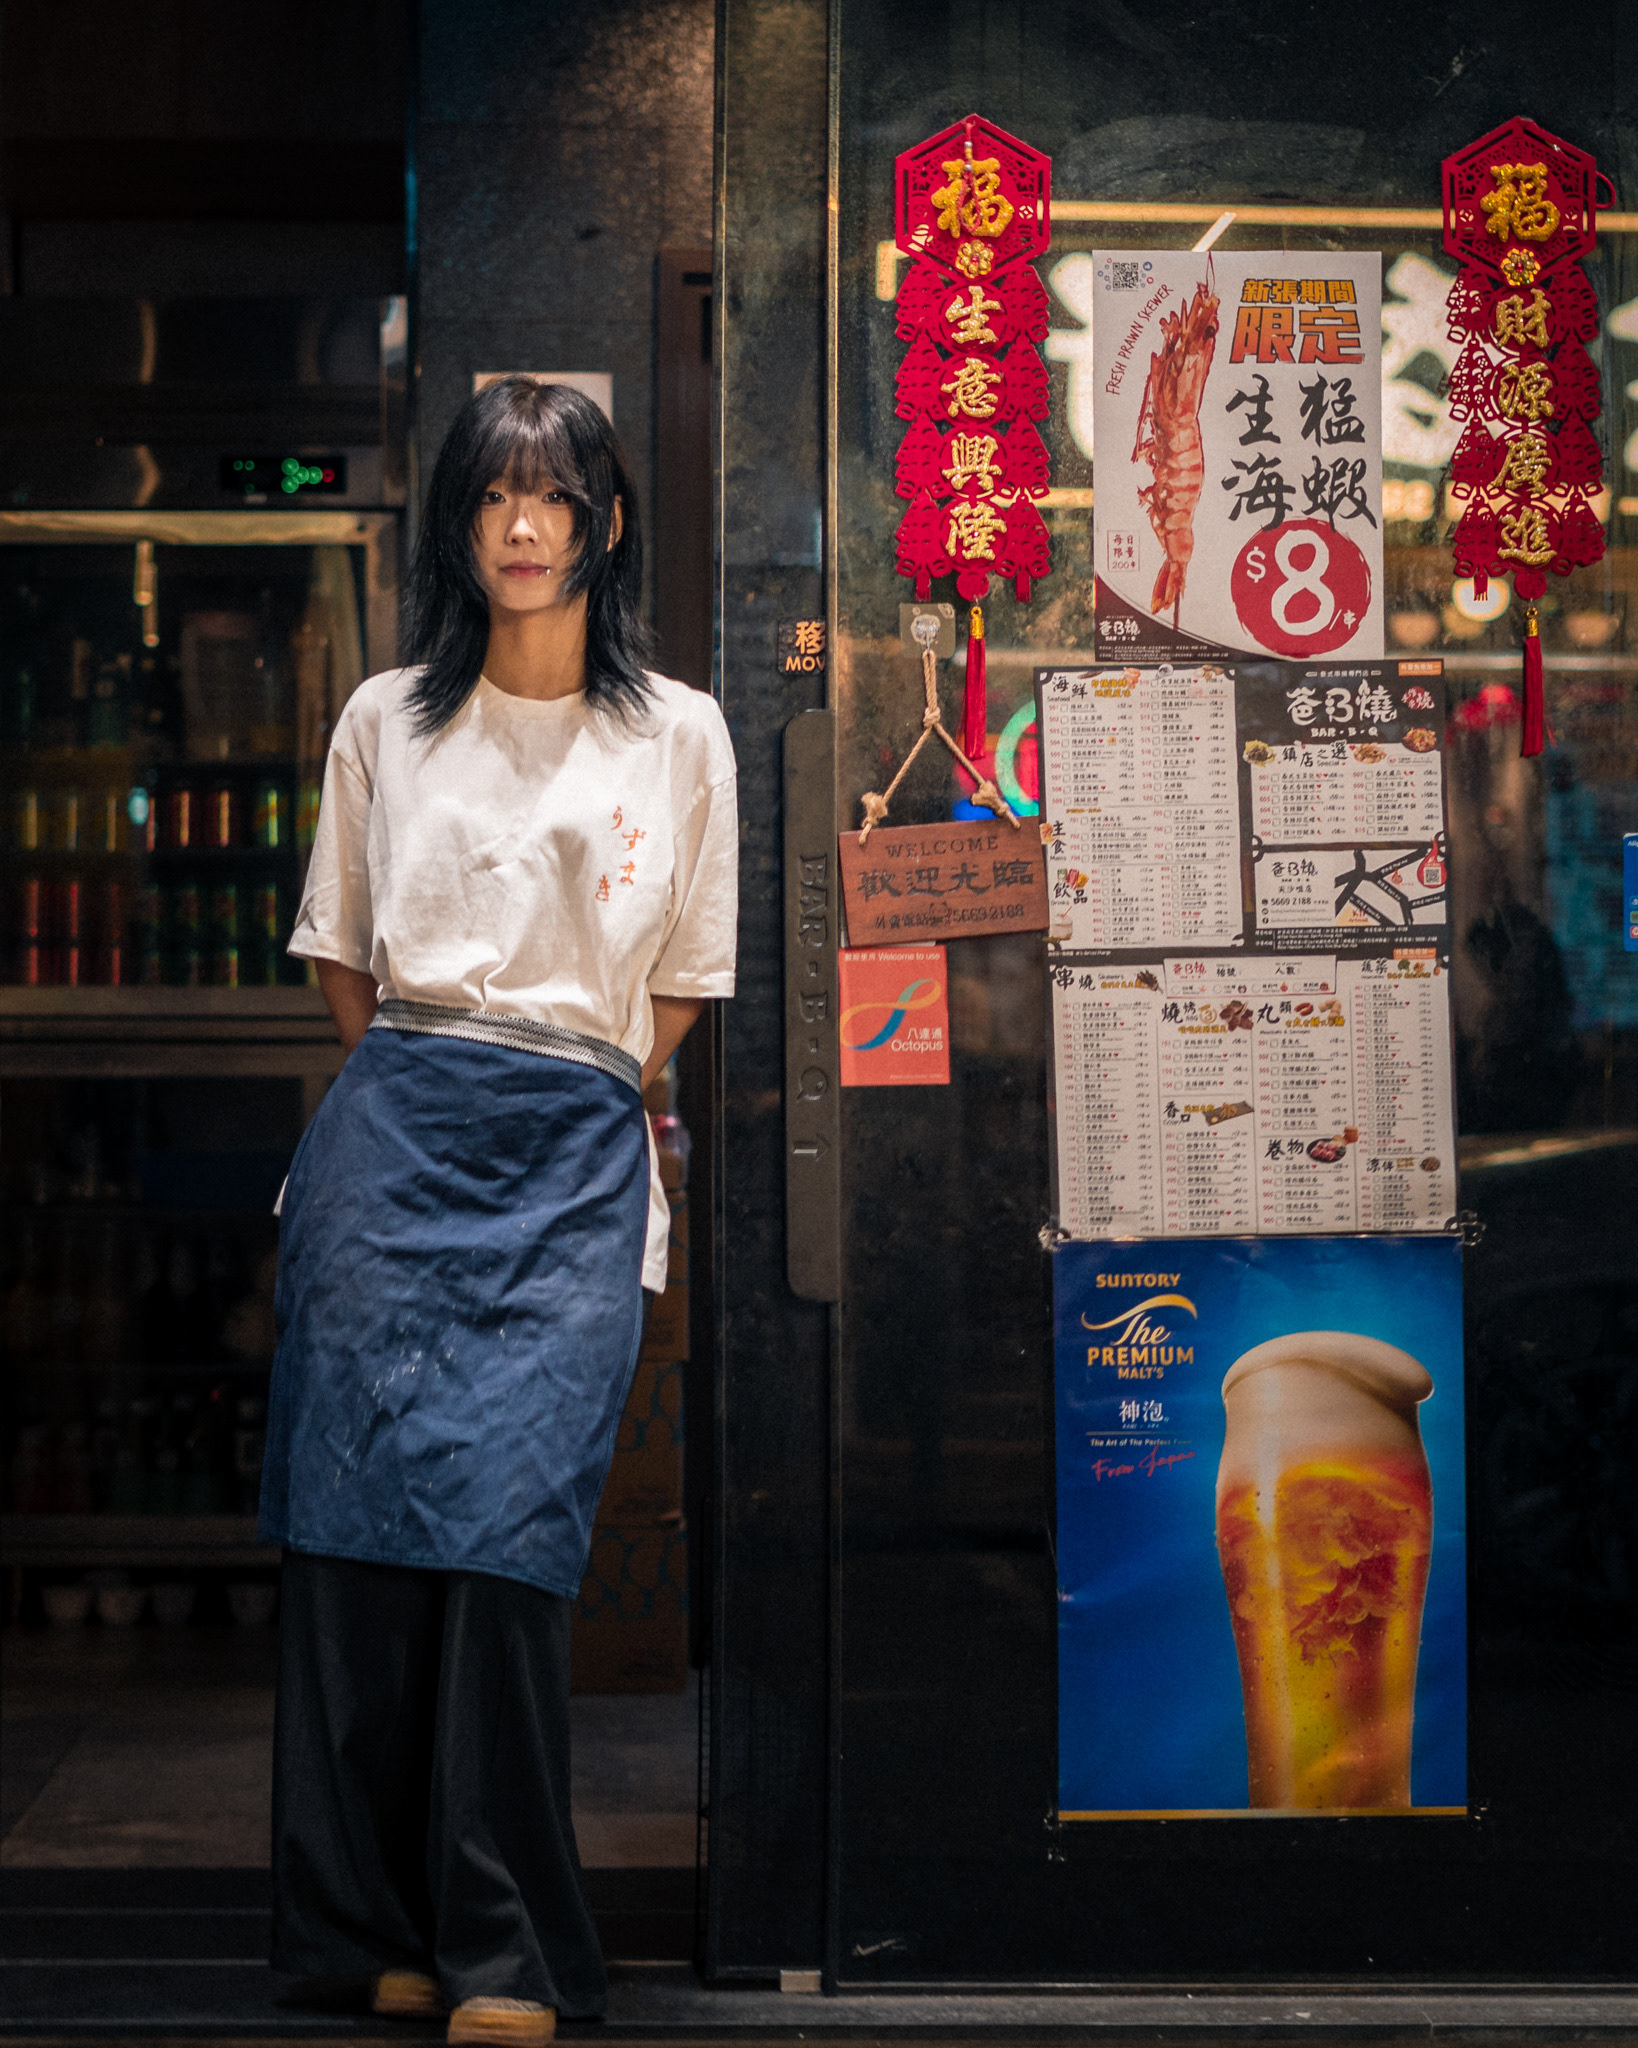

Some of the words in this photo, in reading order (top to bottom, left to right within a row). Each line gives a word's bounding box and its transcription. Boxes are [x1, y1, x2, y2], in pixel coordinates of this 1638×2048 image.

[930, 158, 1013, 239] 福
[1481, 162, 1562, 243] 福
[1241, 278, 1357, 304] 新張期間
[1105, 361, 1130, 395] FRESH
[1118, 320, 1144, 361] PRAWN
[1137, 284, 1174, 322] SKEWER
[1229, 306, 1365, 364] 限定
[1225, 371, 1366, 447] 生猛
[942, 285, 1006, 560] 生意興隆
[1491, 288, 1556, 566] 財源廣進
[1221, 452, 1378, 532] 海蝦
[1052, 675, 1088, 700] 海鮮
[885, 835, 998, 858] WELCOME
[857, 858, 1034, 902] 歡迎光臨
[878, 952, 914, 961] Welcome
[916, 953, 924, 961] to
[1056, 966, 1095, 991] 串燒
[1162, 1001, 1196, 1023] 燒烤
[1256, 1001, 1292, 1024] 丸類
[891, 1040, 943, 1053] Octopus
[1163, 1101, 1190, 1123] 香口
[1265, 1138, 1304, 1160] 卷物
[1110, 1311, 1171, 1346] The
[1087, 1346, 1194, 1366] PREMIUM
[1117, 1367, 1164, 1379] MALT'S
[1091, 1438, 1104, 1446] The
[1106, 1438, 1118, 1446] Art
[1120, 1438, 1128, 1446] of
[1130, 1438, 1143, 1446] The
[1091, 1458, 1134, 1481] From
